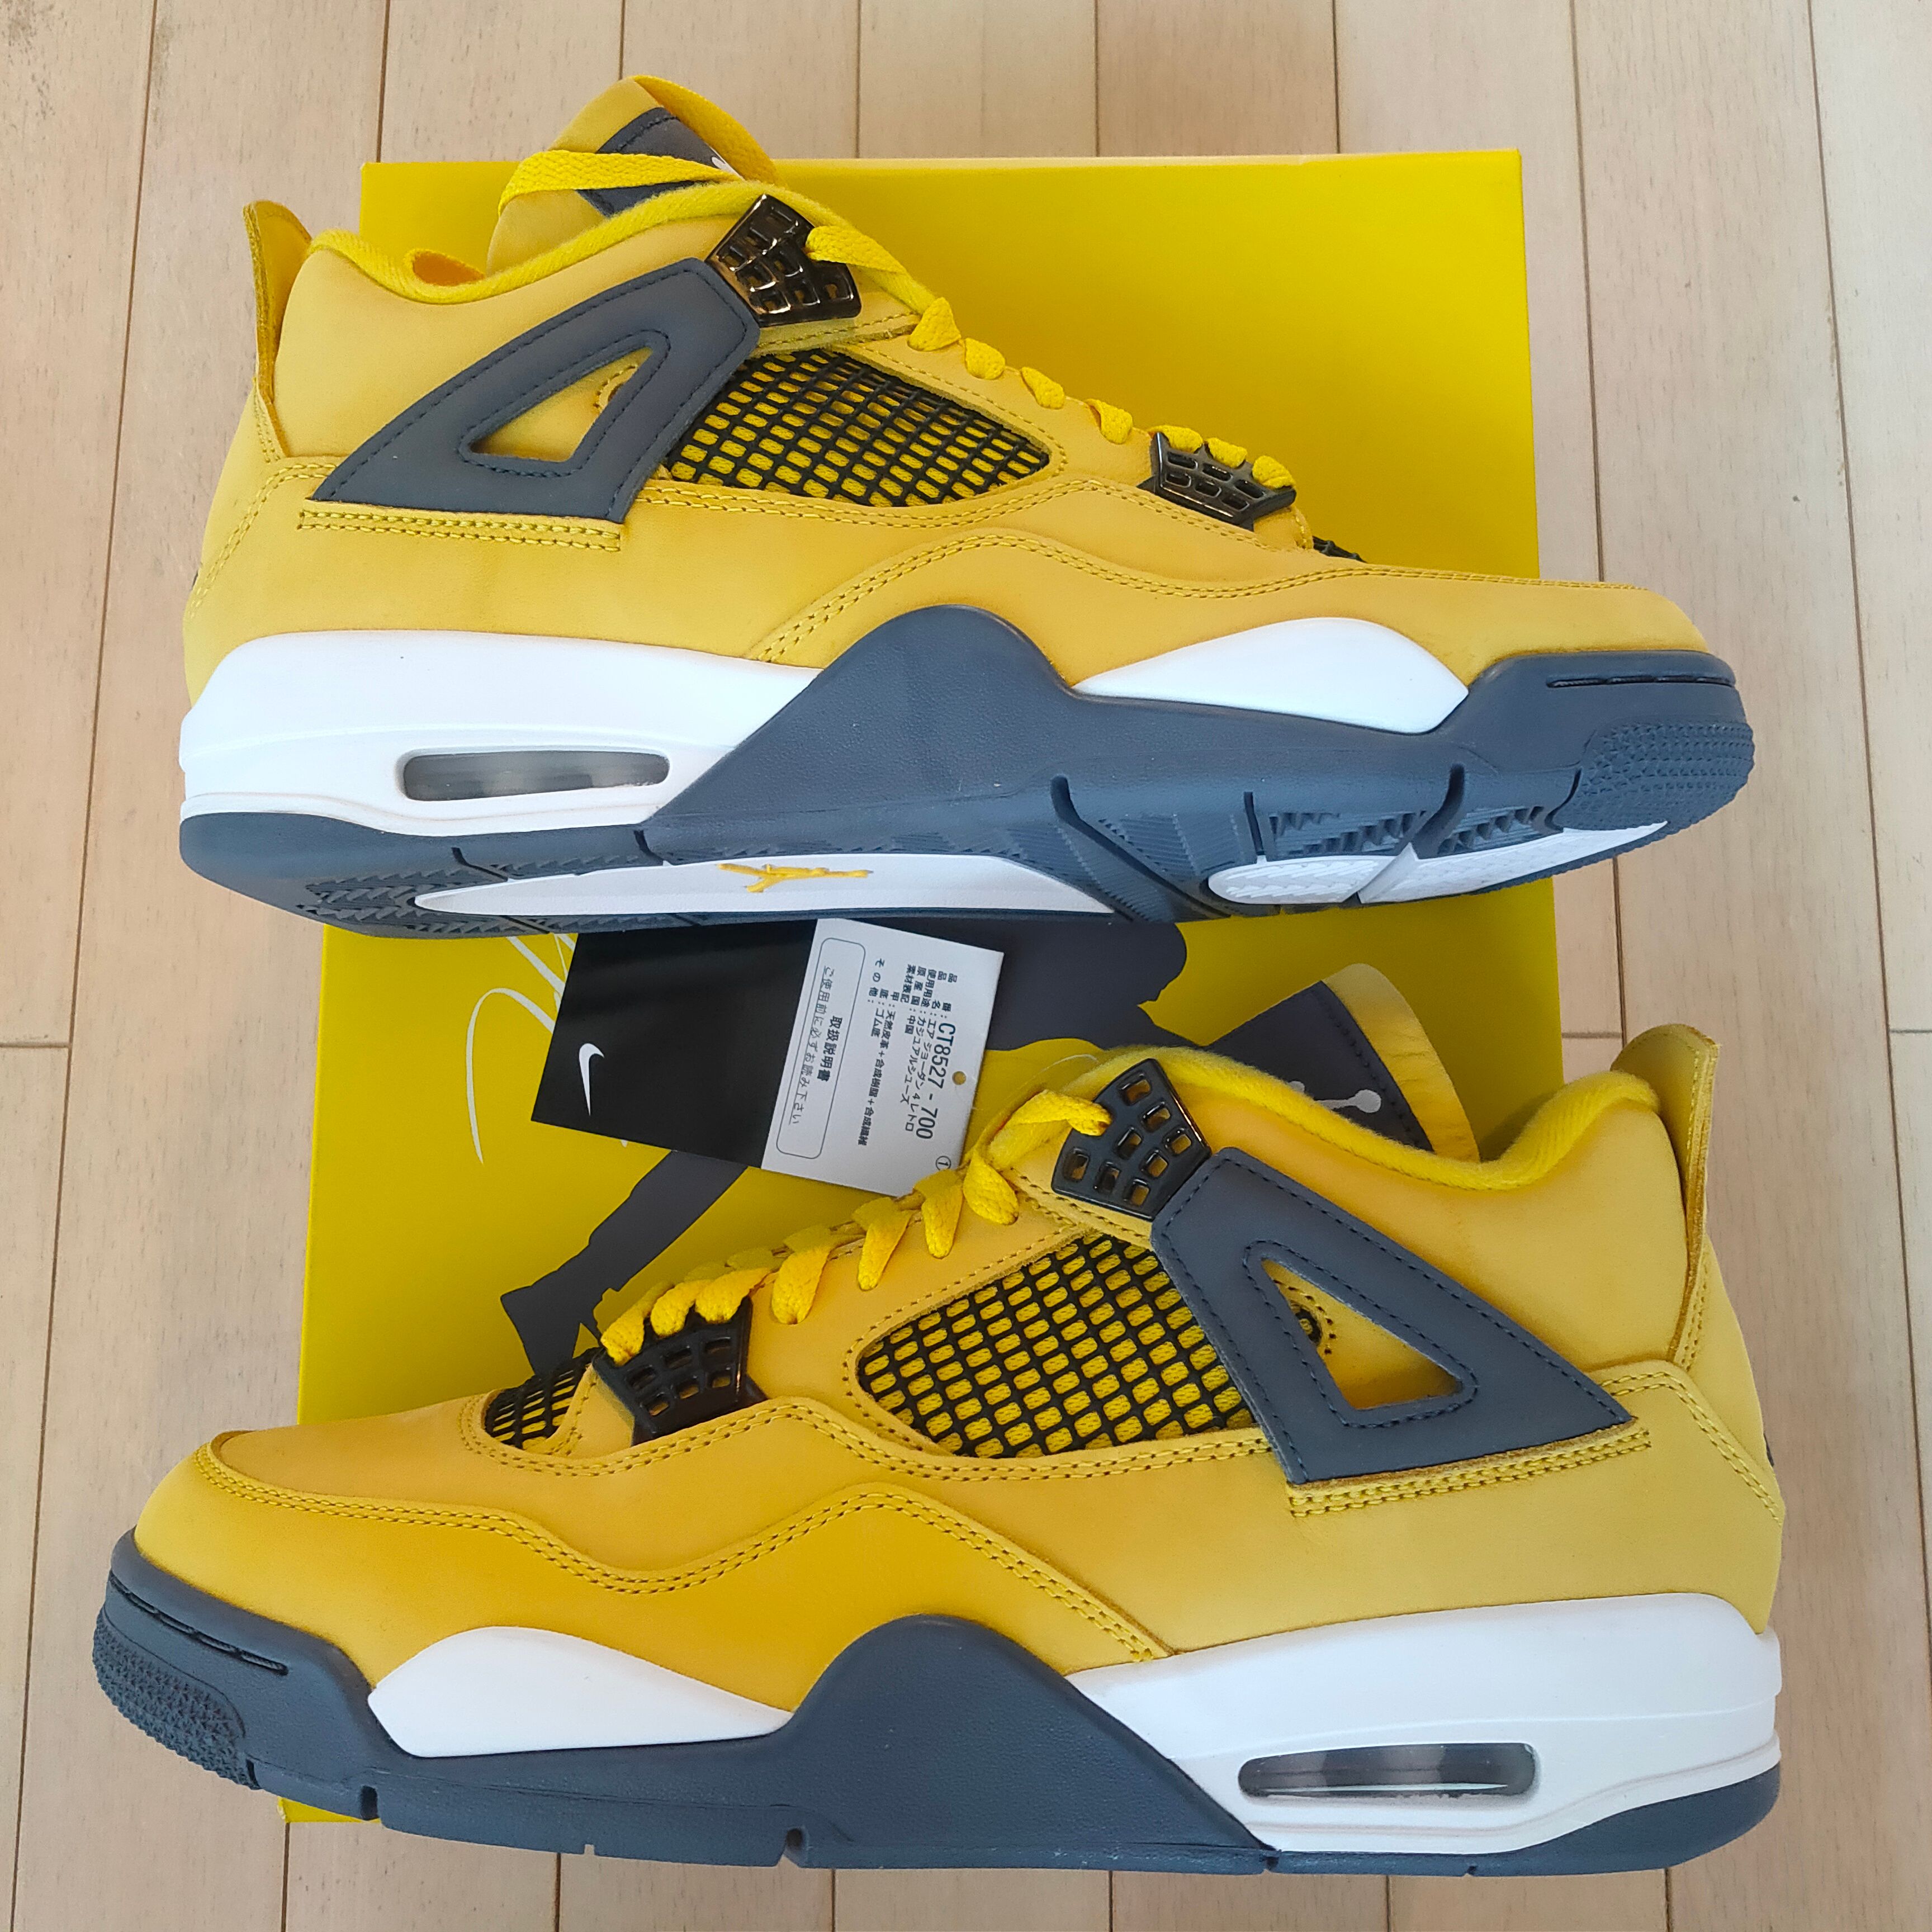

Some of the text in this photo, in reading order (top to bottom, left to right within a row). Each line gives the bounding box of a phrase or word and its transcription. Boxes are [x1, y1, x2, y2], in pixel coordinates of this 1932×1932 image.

[789, 965, 835, 1124] ご使用前に必ずお読み下さい
[870, 1007, 884, 1038] ゴム底
[905, 1015, 916, 1035] 中国
[817, 1015, 843, 1082] 取扱説明書
[927, 1022, 956, 1089] CT8527
[916, 1107, 938, 1139] 700
